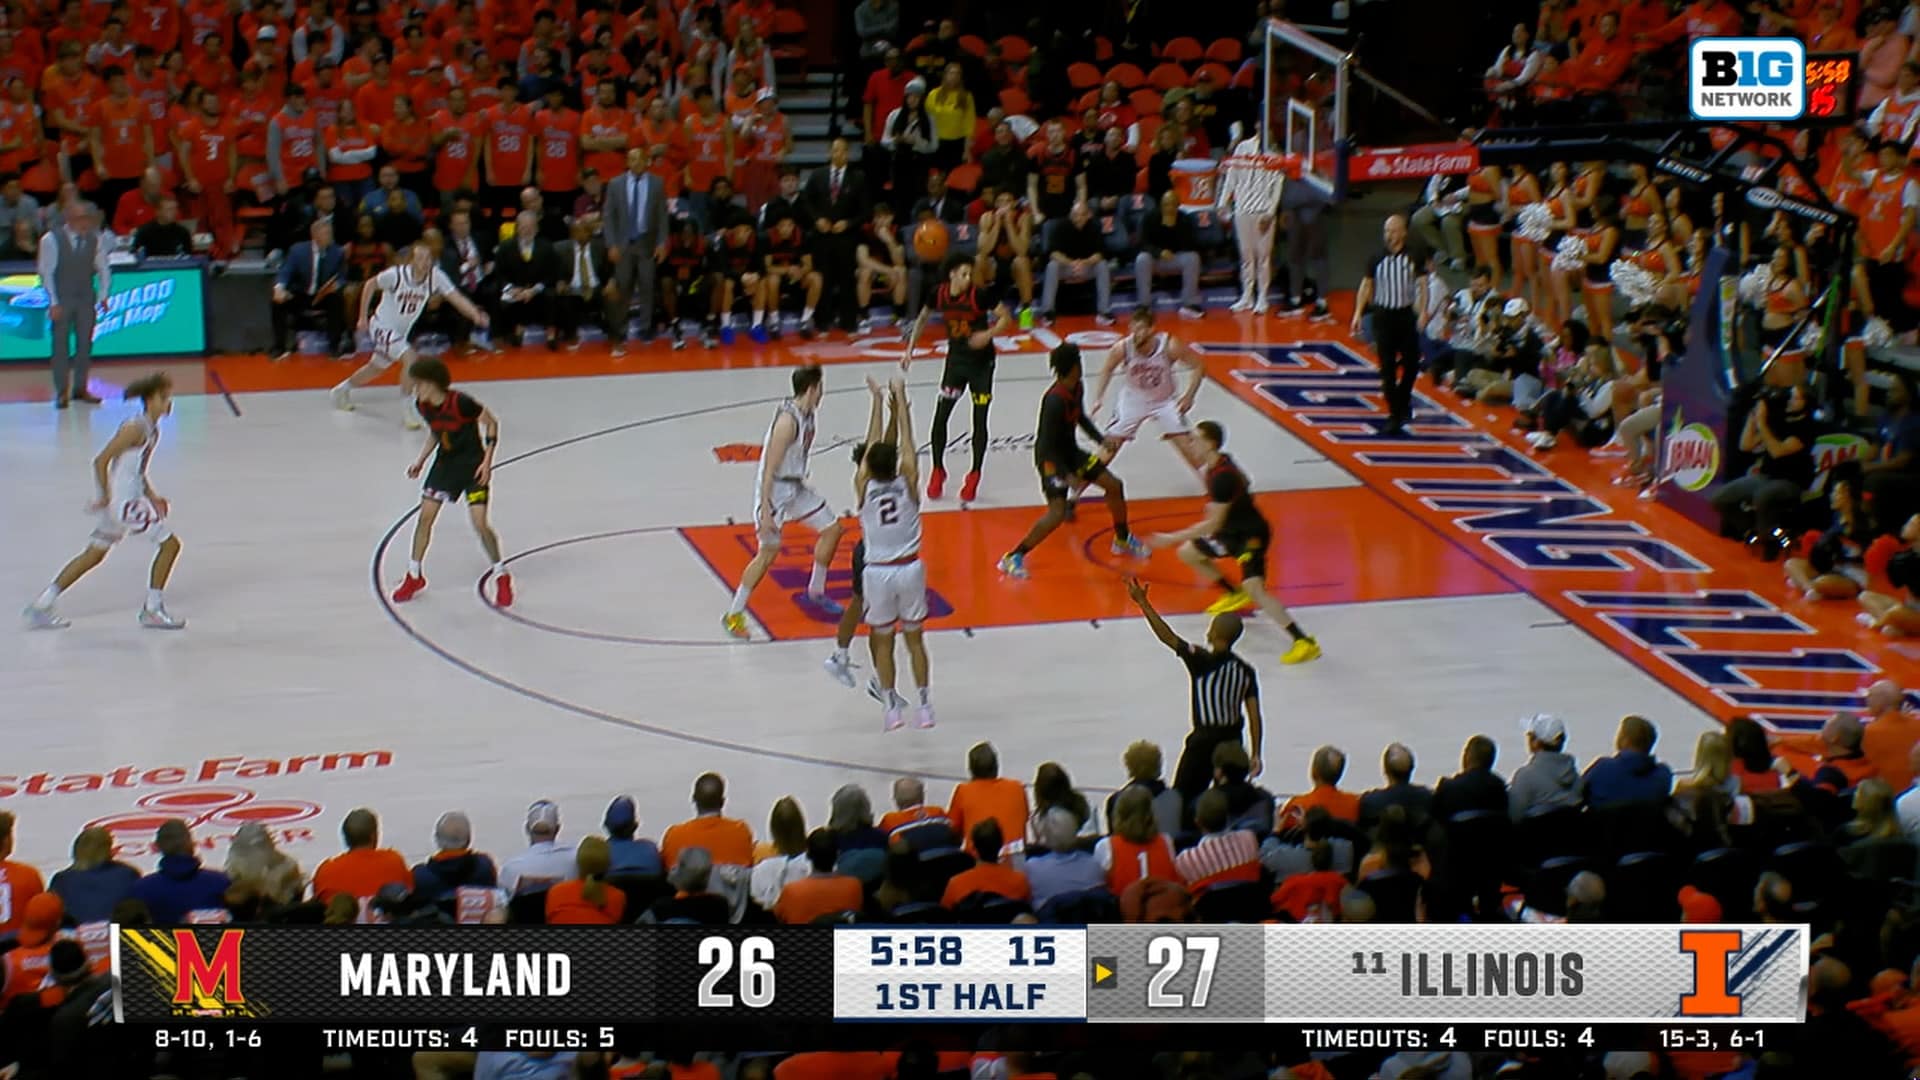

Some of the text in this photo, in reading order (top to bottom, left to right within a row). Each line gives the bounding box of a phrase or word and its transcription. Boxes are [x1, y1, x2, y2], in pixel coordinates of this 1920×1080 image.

[1191, 339, 1713, 573] FIGHTING
[879, 498, 898, 525] 2
[1137, 850, 1148, 879] 1
